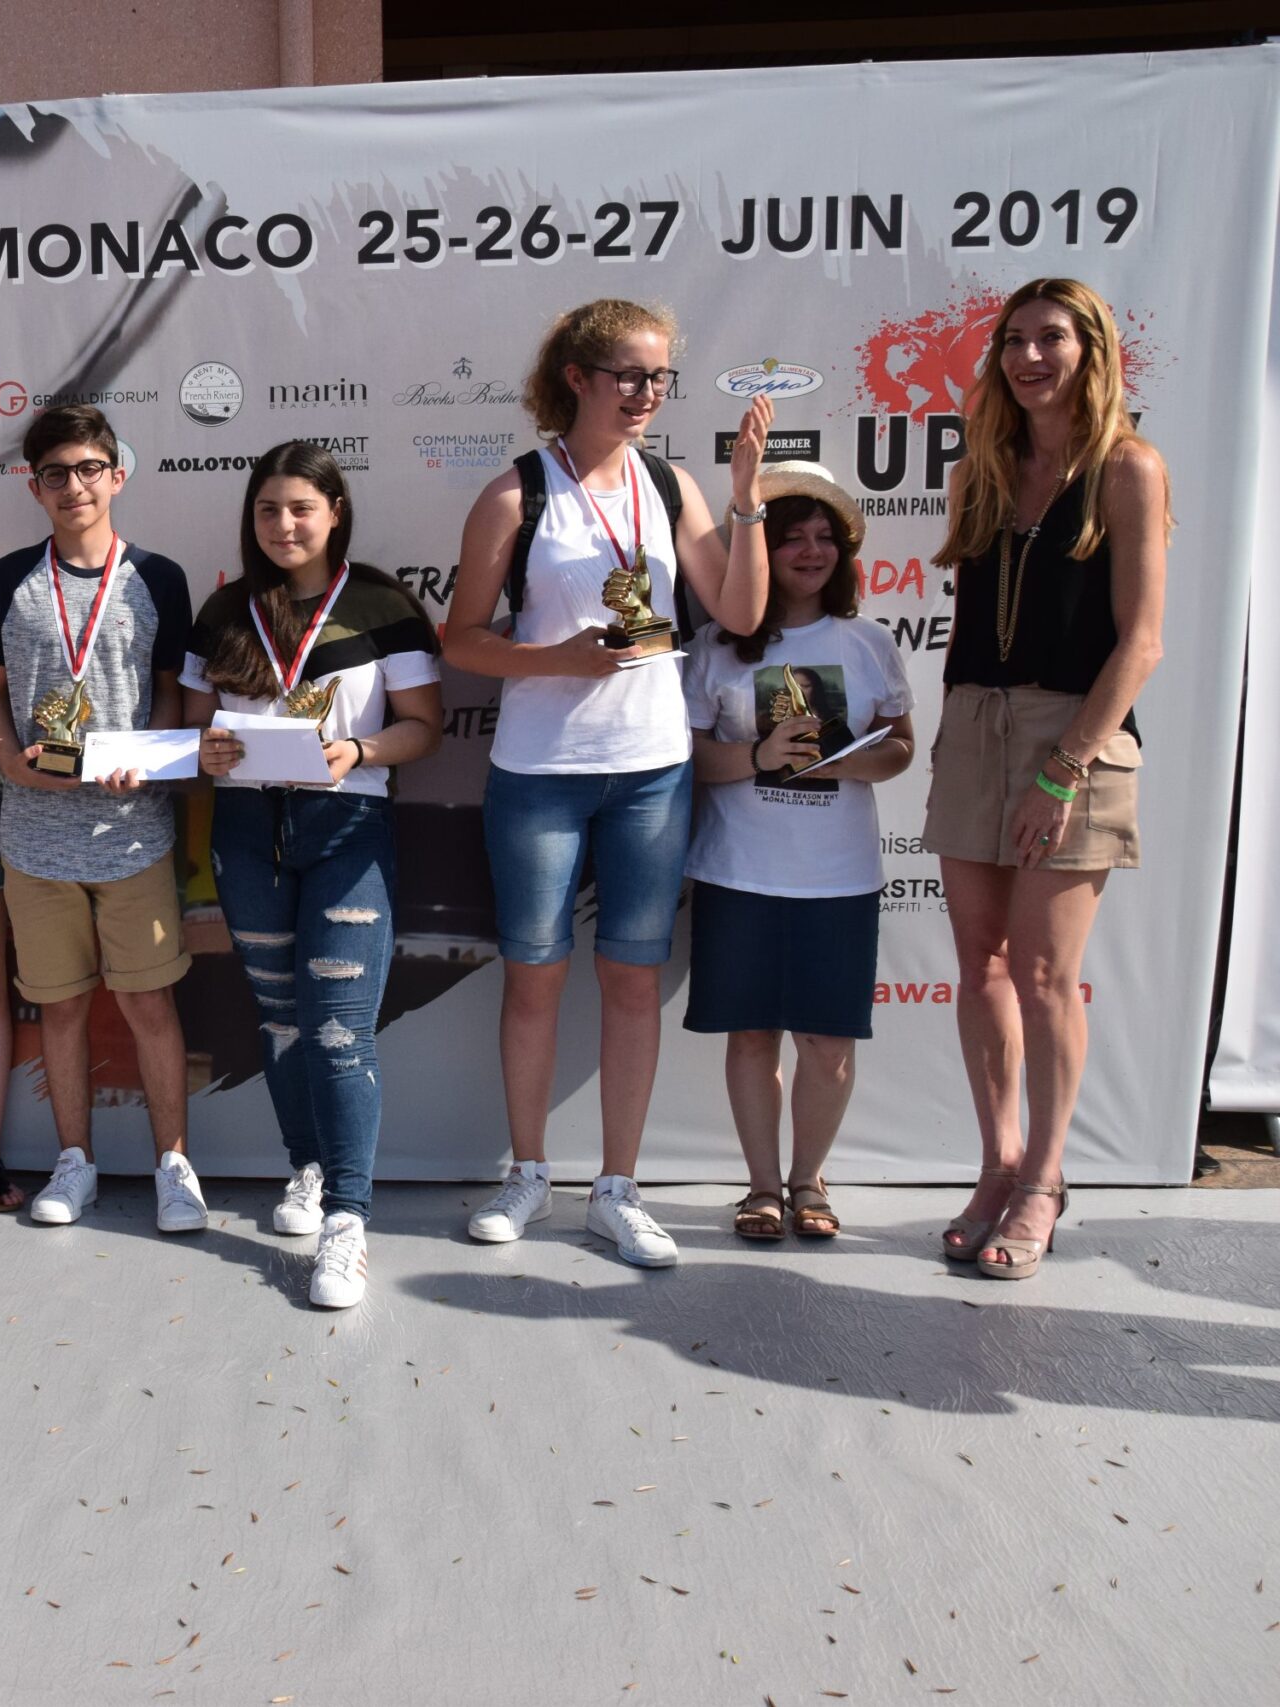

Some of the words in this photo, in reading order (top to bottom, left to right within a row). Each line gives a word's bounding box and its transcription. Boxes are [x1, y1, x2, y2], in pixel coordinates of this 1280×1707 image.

[357, 201, 681, 264] 25-26-27
[721, 194, 903, 255] JUIN
[951, 187, 1138, 247] 2019
[269, 377, 368, 403] marin
[392, 382, 456, 406] Brooks
[349, 457, 369, 465] 2014
[426, 459, 442, 468] DE
[445, 457, 502, 468] MONACO
[754, 788, 768, 796] THE
[792, 792, 821, 800] REASON
[762, 796, 785, 804] MONA
[786, 798, 804, 806] LISA
